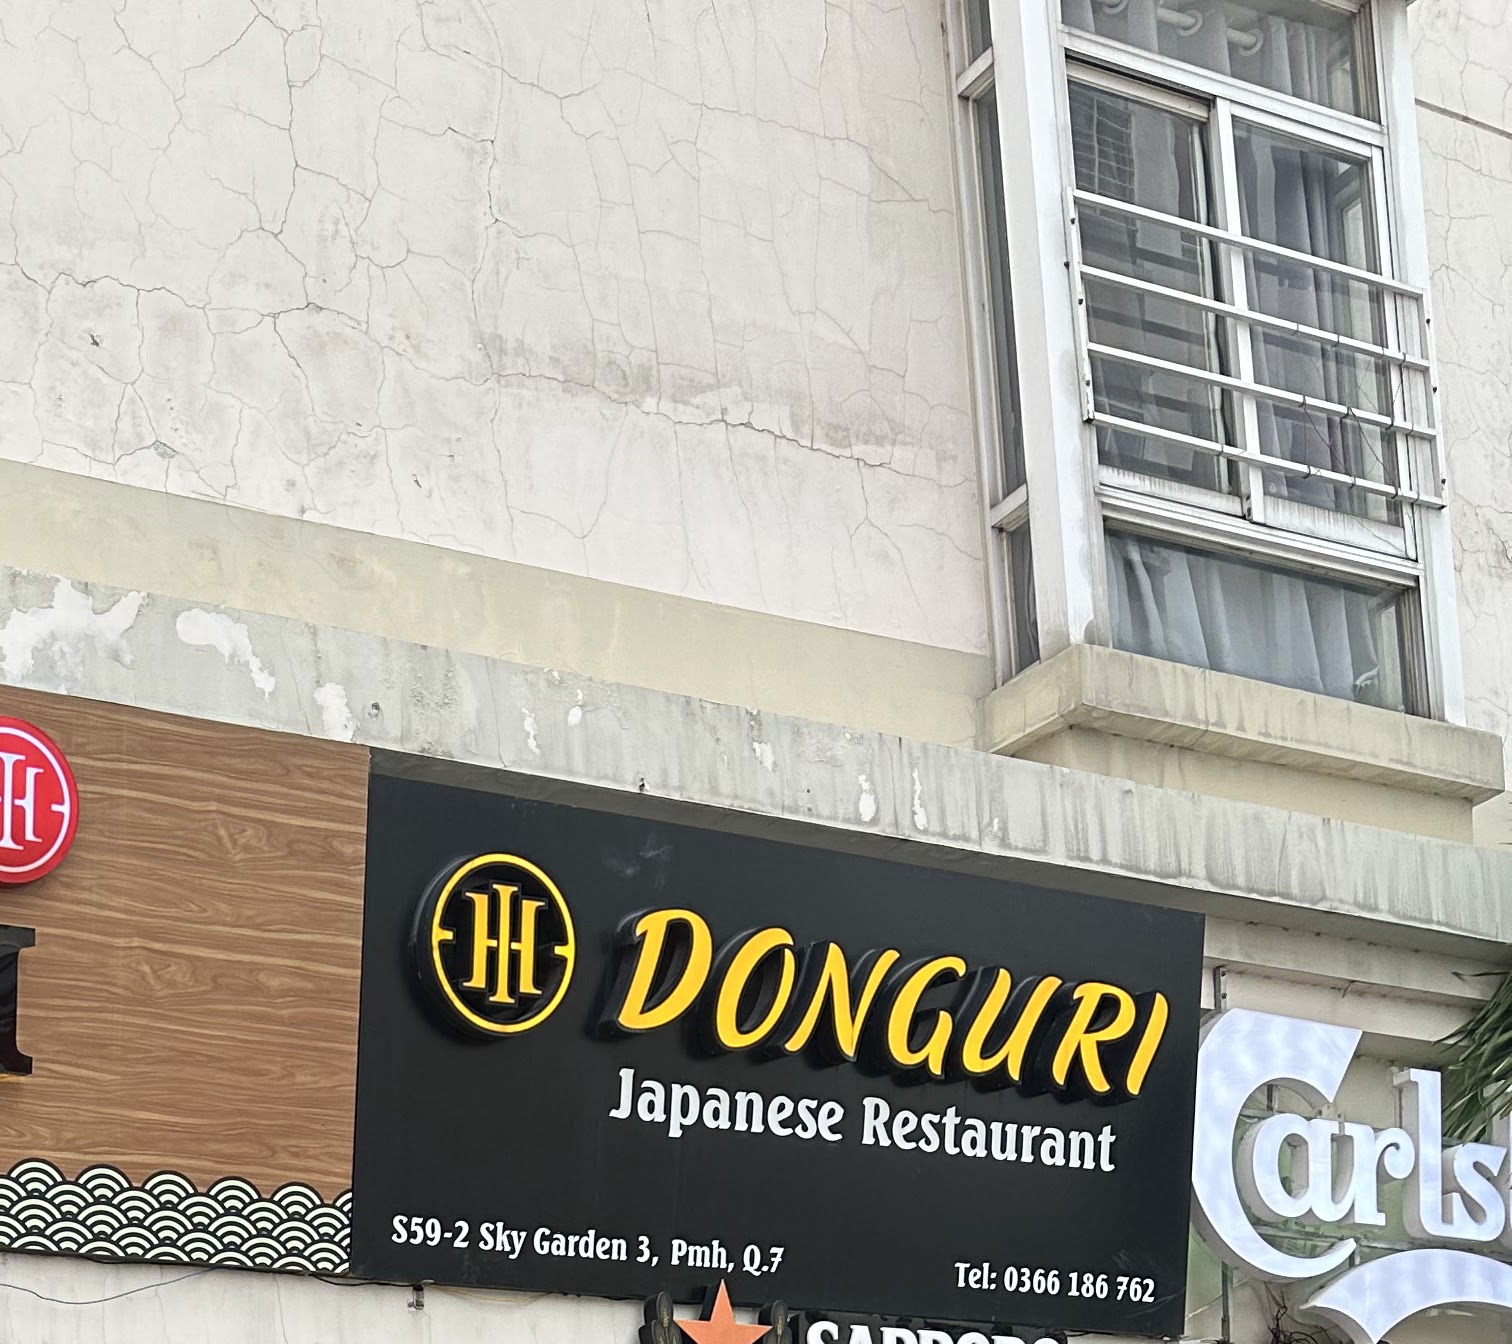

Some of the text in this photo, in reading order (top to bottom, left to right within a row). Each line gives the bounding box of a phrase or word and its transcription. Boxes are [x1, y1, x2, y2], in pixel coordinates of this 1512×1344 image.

[617, 908, 1169, 1096] DONGURI
[609, 1068, 1117, 1172] Japanese Restaurant
[1192, 1008, 1512, 1277] Carls
[391, 1214, 785, 1277] S59-2 Sky Garden 3, Pmh, Q.7
[954, 1262, 1156, 1303] Tel: 0366 186 762
